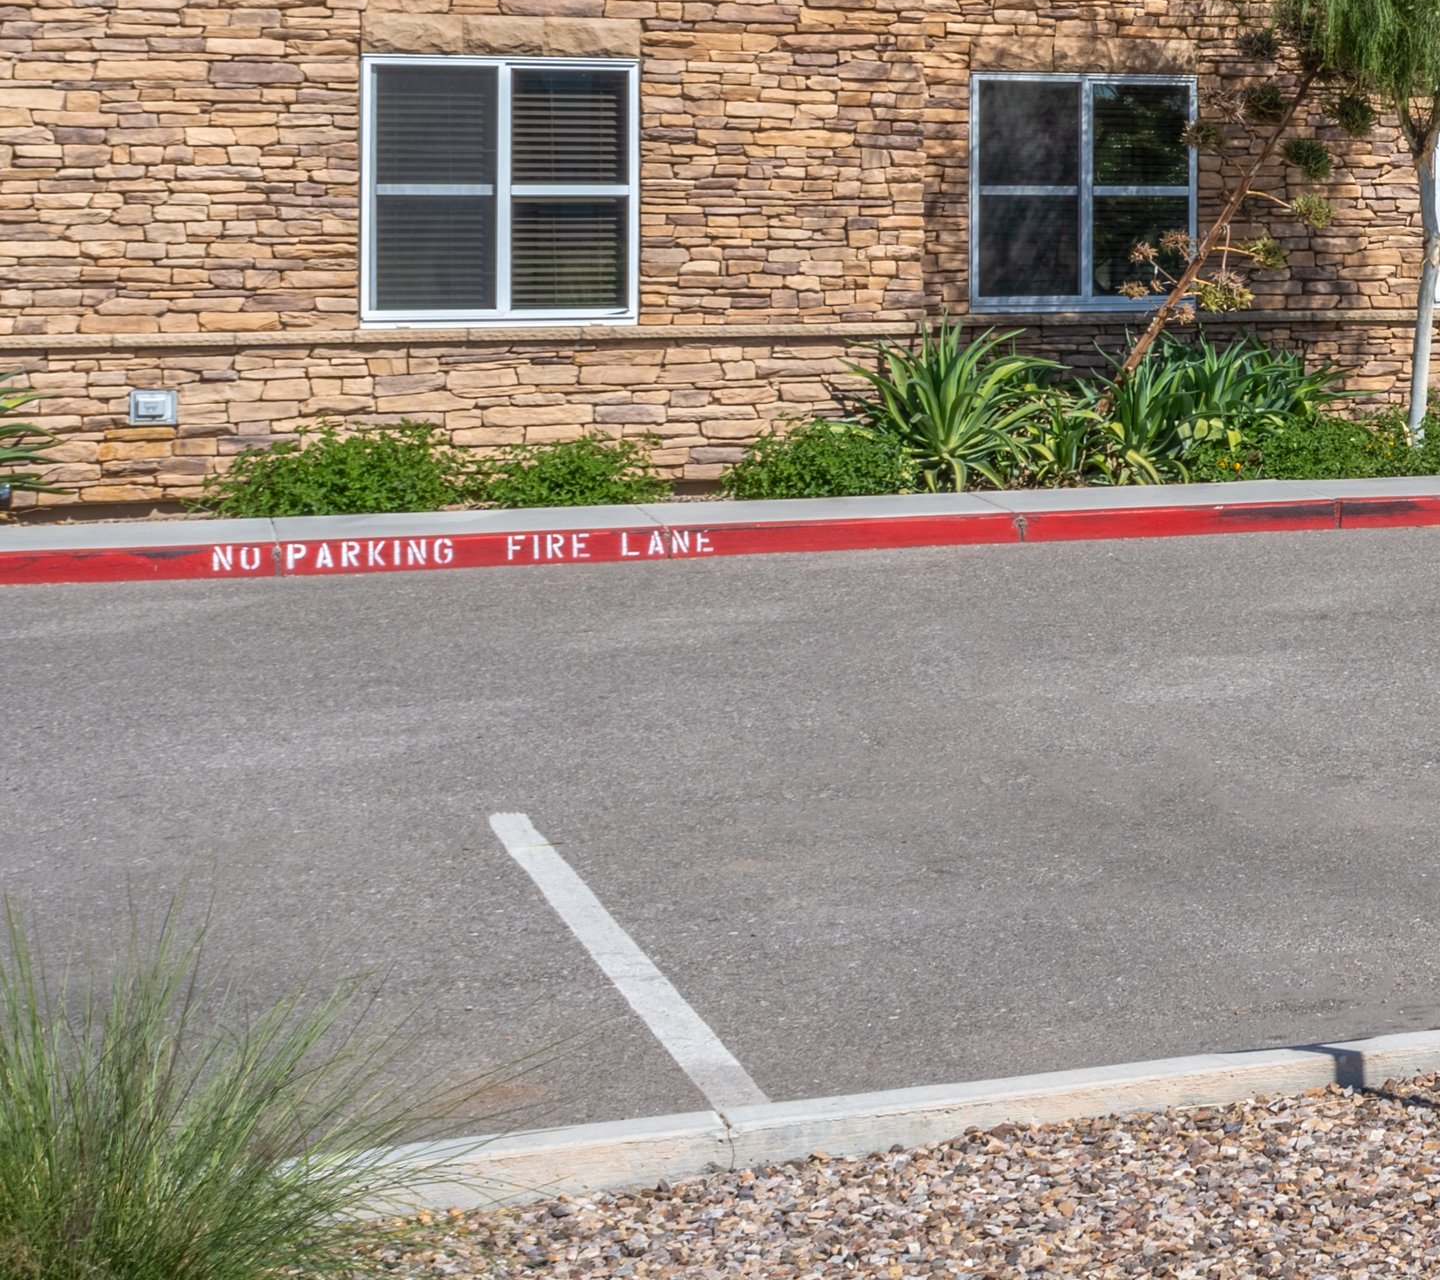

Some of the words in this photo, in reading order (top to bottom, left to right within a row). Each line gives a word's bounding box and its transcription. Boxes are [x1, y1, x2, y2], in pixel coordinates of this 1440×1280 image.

[212, 545, 261, 571] NO
[286, 537, 454, 570] PARKING
[507, 533, 591, 560] FIRE
[621, 529, 714, 557] LANE
